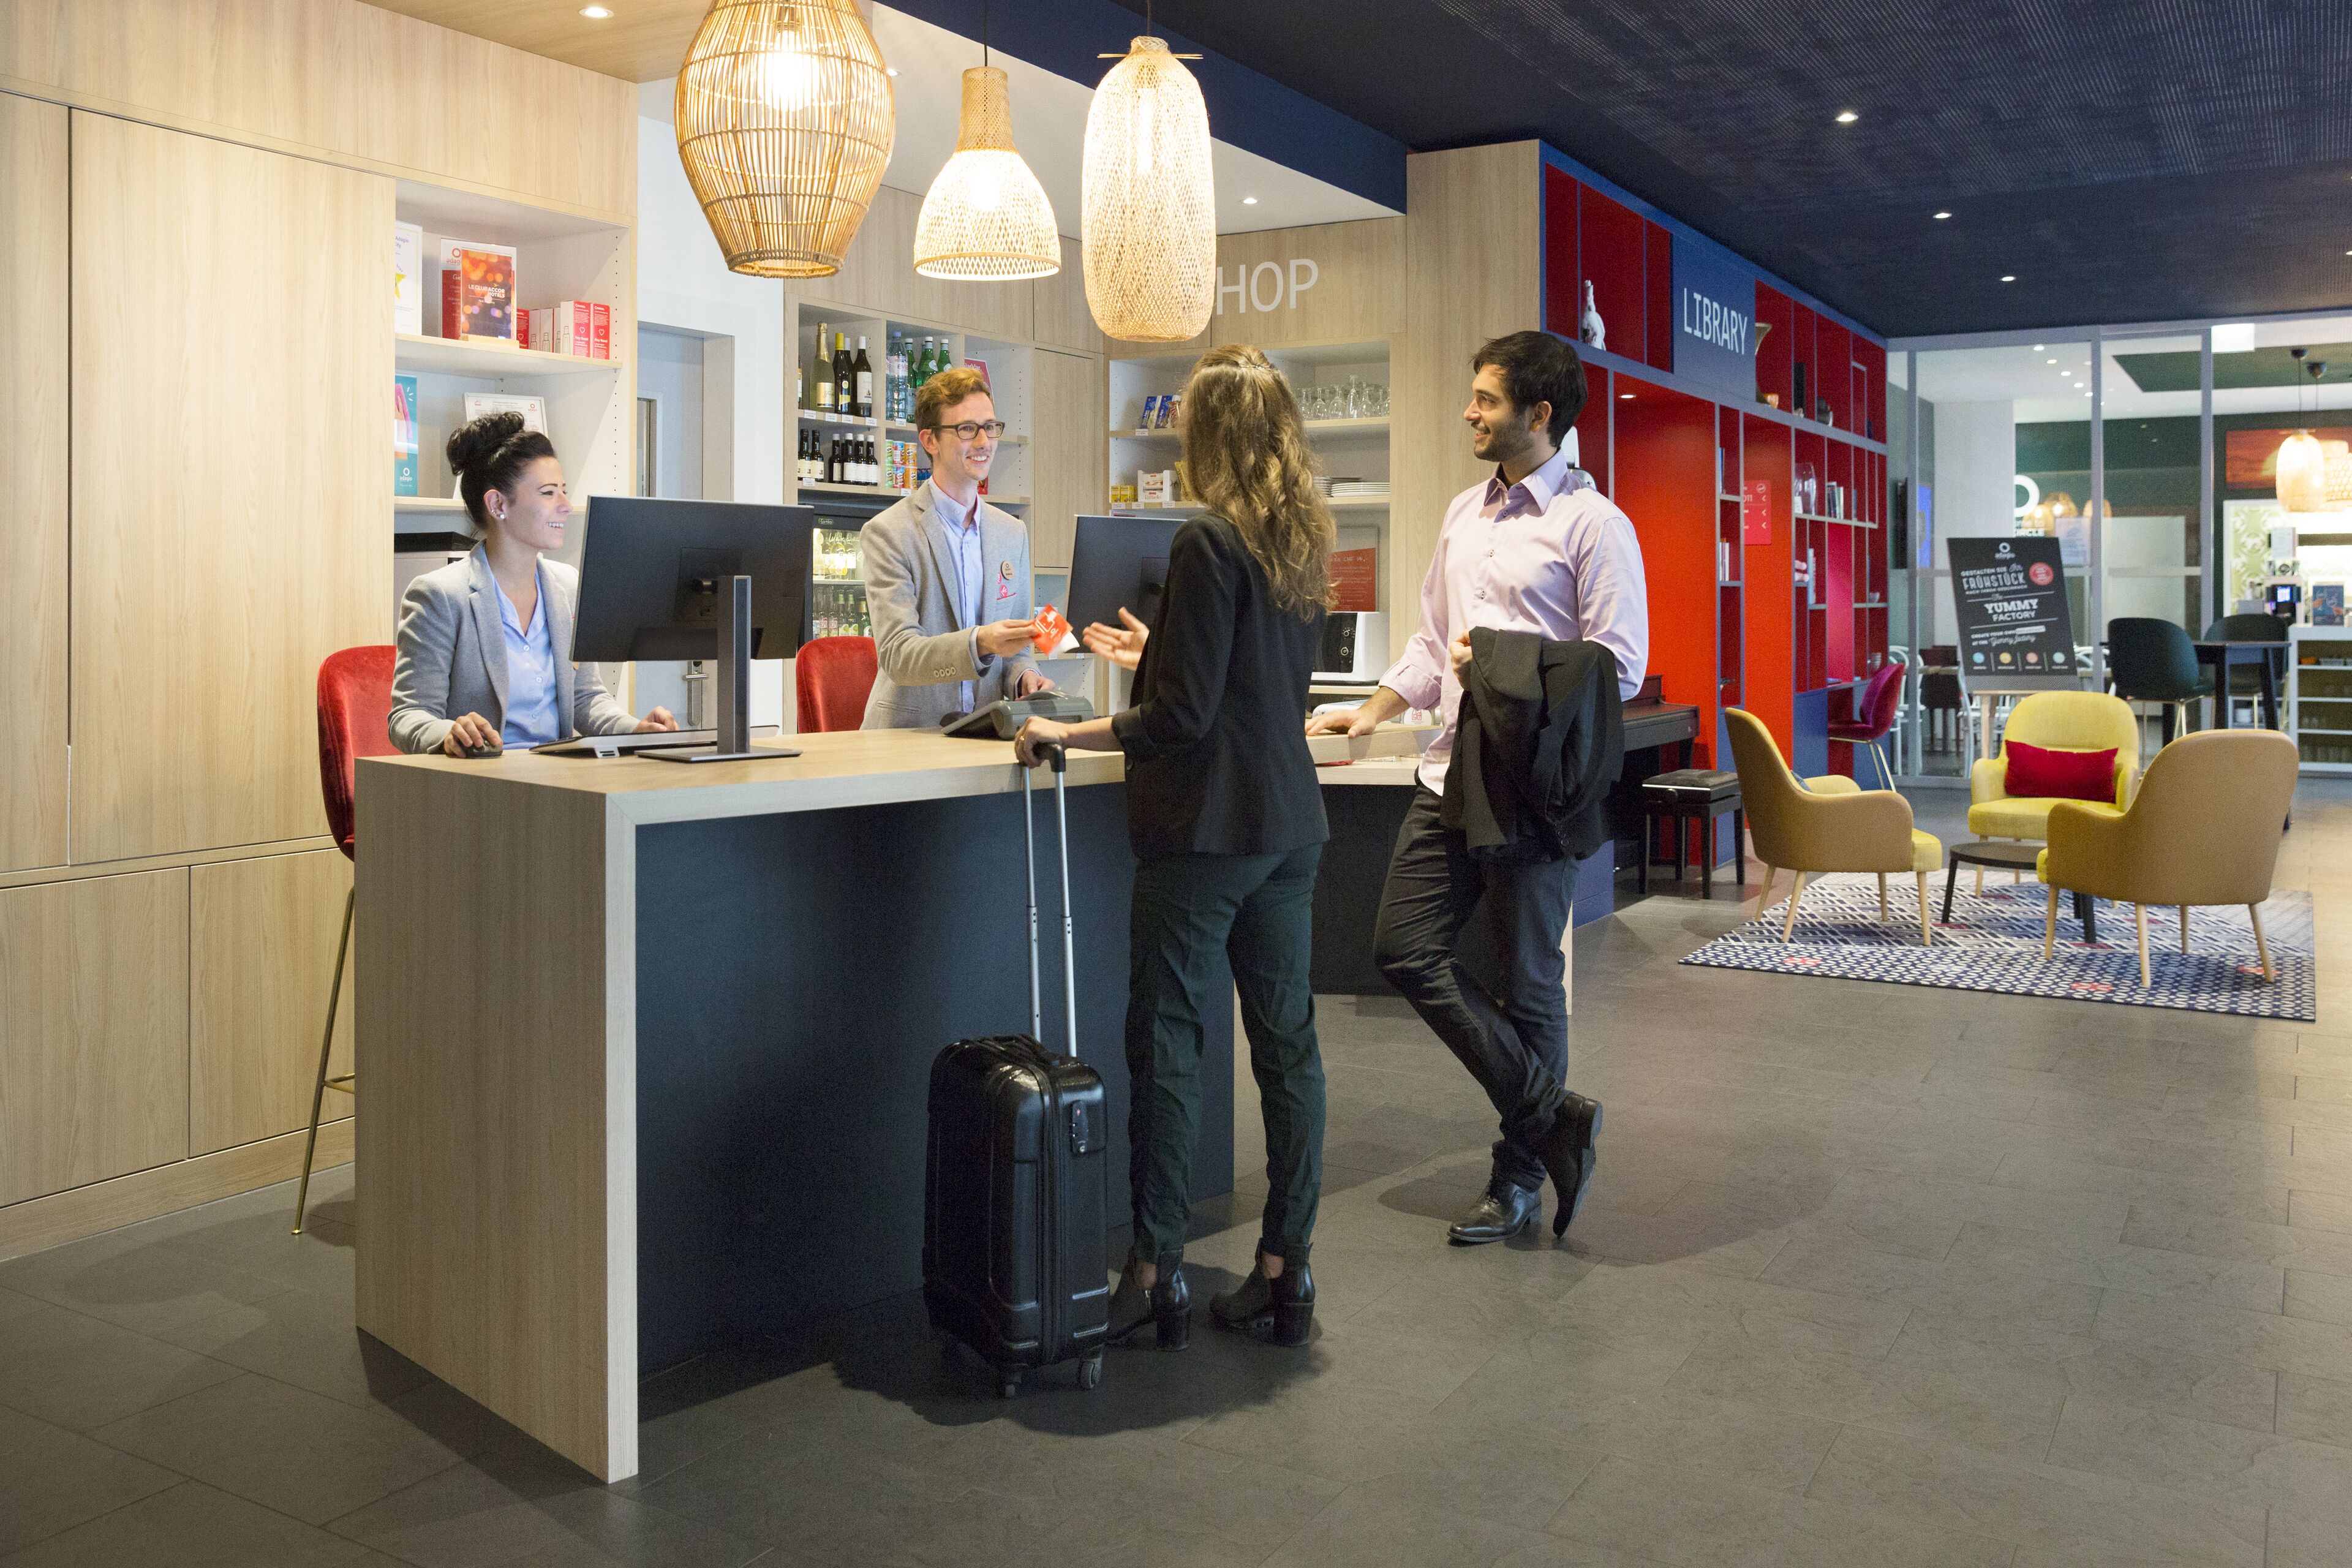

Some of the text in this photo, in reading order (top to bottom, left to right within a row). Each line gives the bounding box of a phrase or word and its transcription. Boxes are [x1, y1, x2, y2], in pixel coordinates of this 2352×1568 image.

[1216, 258, 1319, 315] HOP
[1684, 287, 1748, 355] LIBRARY
[1962, 571, 2026, 591] FRÜHSTÜCK
[1984, 598, 2039, 614] YUMMY
[1992, 610, 2036, 622] FACTORY
